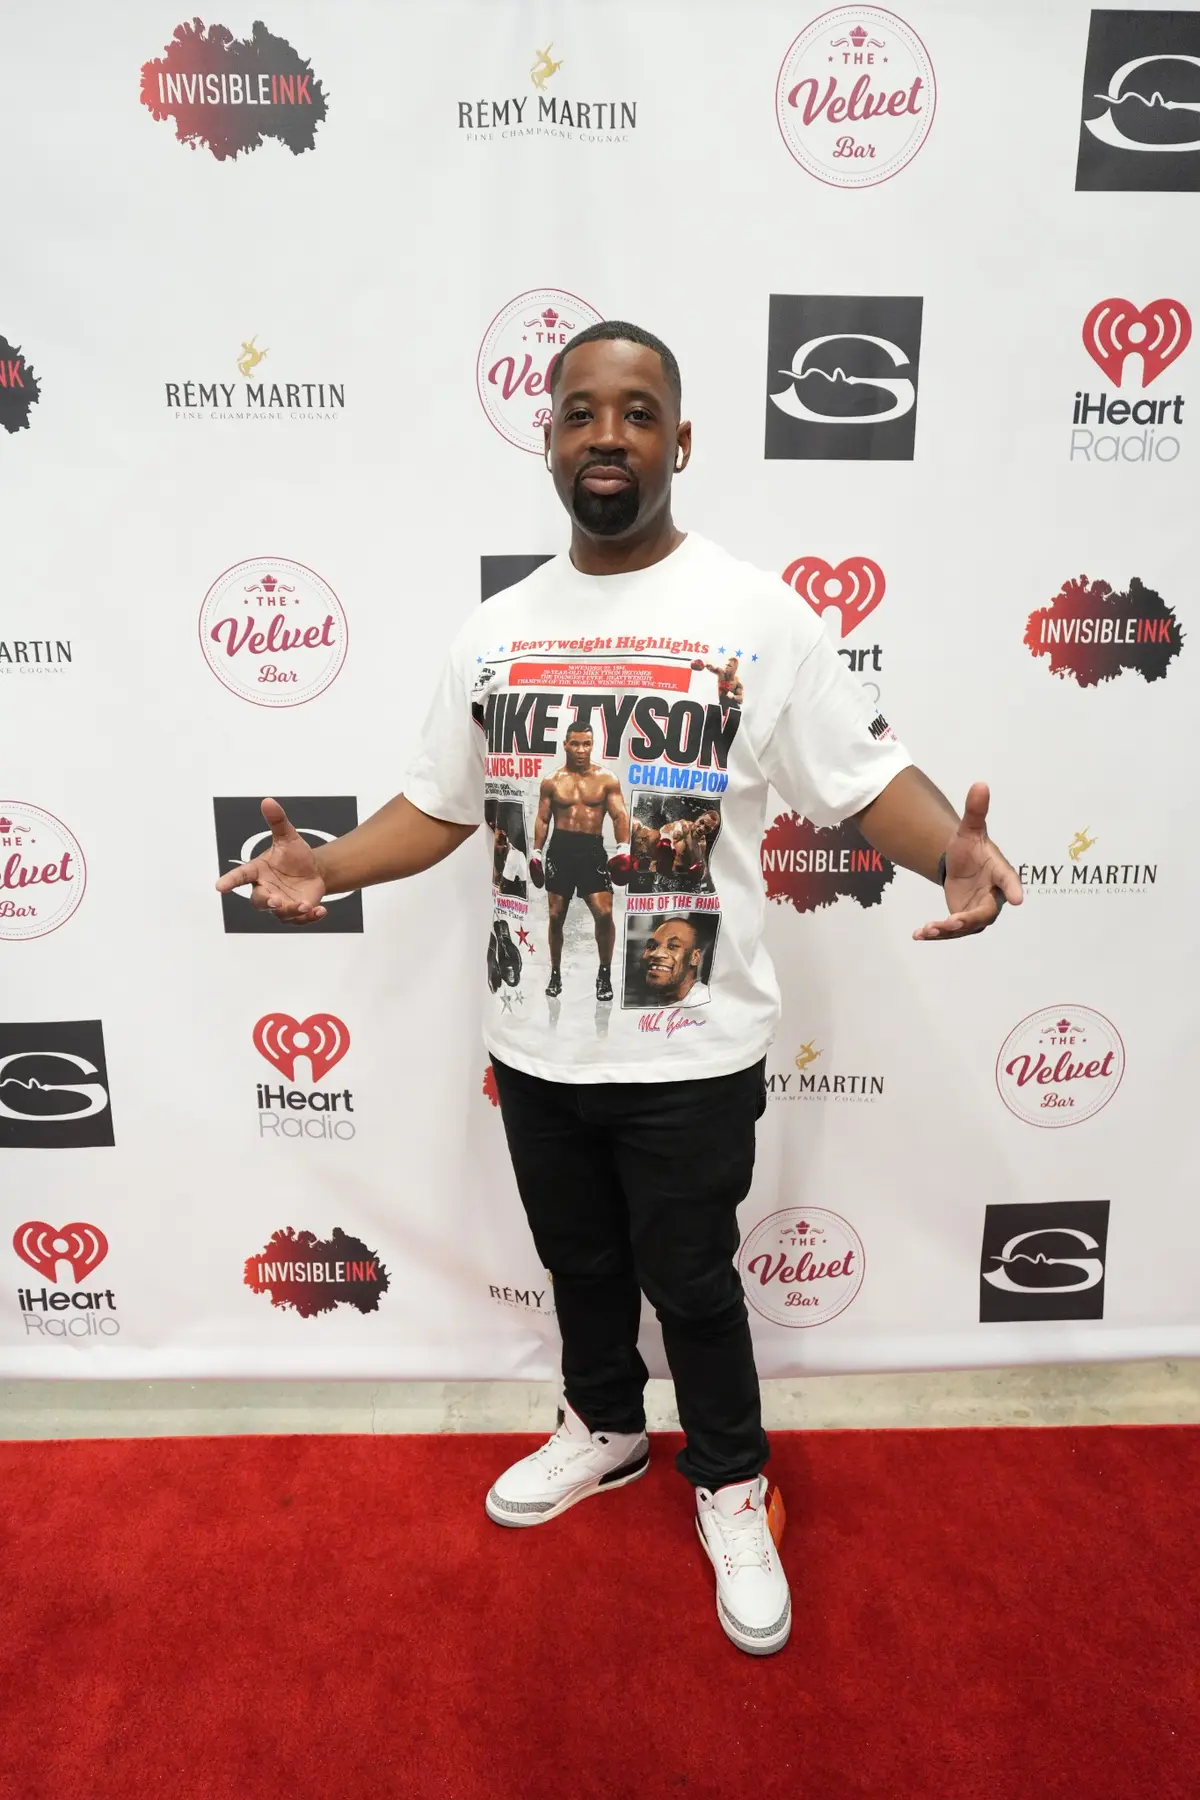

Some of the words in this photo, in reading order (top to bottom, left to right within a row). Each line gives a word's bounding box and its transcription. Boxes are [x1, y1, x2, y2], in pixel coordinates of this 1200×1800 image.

[842, 52, 875, 65] THE
[787, 74, 925, 127] Velvet
[458, 96, 528, 129] RÉMY
[538, 96, 638, 129] MARTIN
[466, 133, 494, 141] FINE
[502, 128, 573, 140] CHAMPAGNE
[580, 133, 629, 143] COGNAC
[832, 136, 877, 159] Bar
[536, 332, 566, 345] THE
[164, 381, 236, 408] RÉMY
[246, 383, 345, 408] MARTIN
[175, 412, 203, 420] FINE
[210, 412, 283, 420] CHAMPAGNE
[290, 412, 338, 420] COGNAC
[1072, 392, 1185, 426] iHeart
[1070, 429, 1181, 463] Radio
[256, 596, 287, 607] THE
[210, 613, 337, 658] Velvet
[511, 637, 612, 653] Heavyweight
[615, 636, 710, 654] Highlights
[257, 664, 299, 684] Bar
[568, 693, 741, 770] TYSON
[628, 764, 729, 793] CHAMPION
[0, 852, 74, 889] lvet
[1070, 865, 1158, 885] MARTIN
[1037, 887, 1100, 895] CHAMPAGNE
[1106, 887, 1148, 895] COGNAC
[0, 900, 38, 918] Bar
[627, 896, 654, 911] KING
[658, 896, 670, 911] OF
[672, 896, 692, 909] THE
[695, 897, 720, 911] RING
[1049, 1036, 1076, 1046] THE
[1005, 1050, 1116, 1088] Velvet
[799, 1074, 885, 1094] MARTIN
[256, 1084, 354, 1113] iHeart
[1039, 1092, 1076, 1109] Bar
[259, 1111, 356, 1141] Radio
[790, 1236, 816, 1246] THE
[747, 1249, 856, 1286] Velvet
[18, 1288, 117, 1312] iHeart
[488, 1285, 546, 1308] RÉMY
[784, 1291, 820, 1308] Bar
[23, 1312, 120, 1338] Radio
